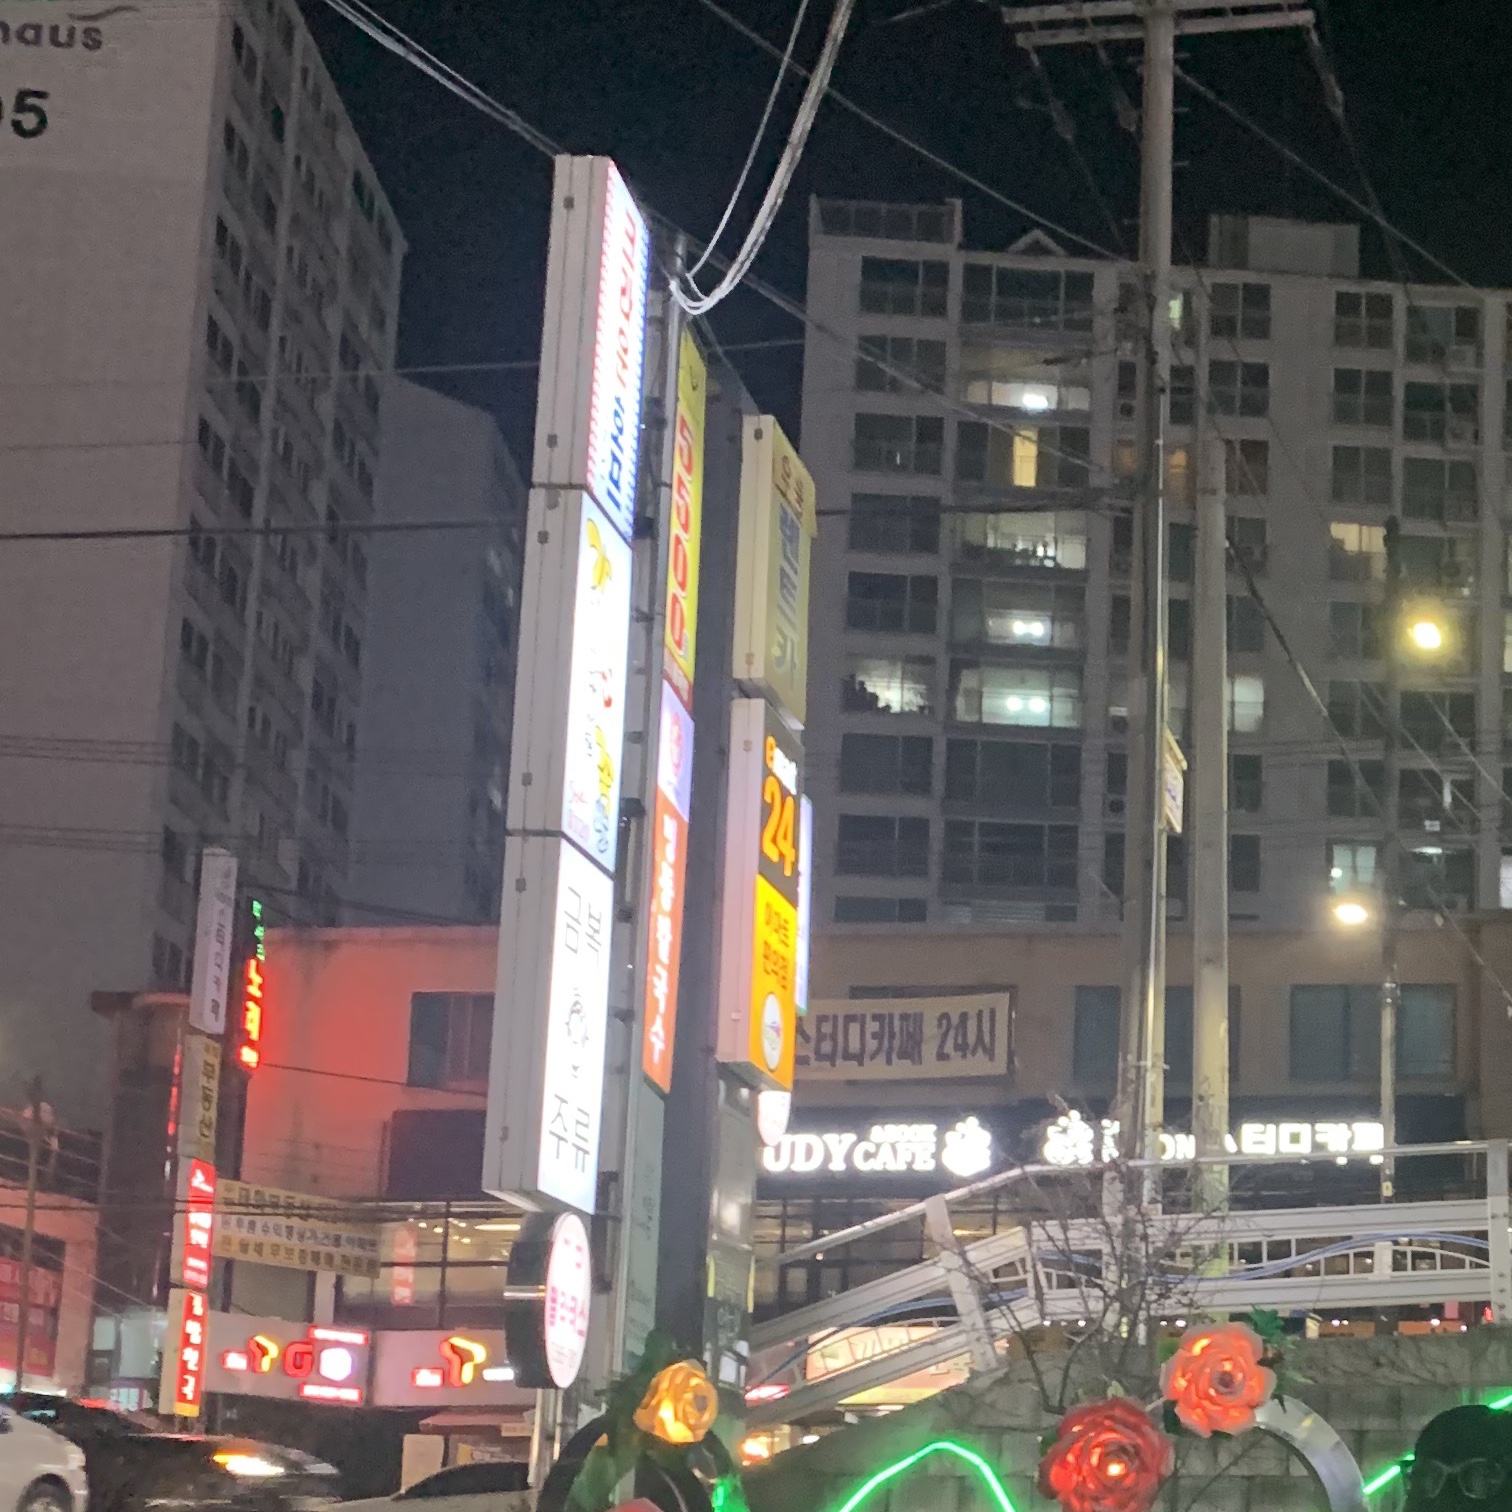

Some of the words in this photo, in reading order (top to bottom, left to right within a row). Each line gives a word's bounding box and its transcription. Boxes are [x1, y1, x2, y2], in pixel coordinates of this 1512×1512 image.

[0, 87, 51, 139] 5
[762, 774, 797, 877] 24
[561, 884, 604, 970] 금복
[935, 1009, 997, 1063] 24시
[547, 1093, 592, 1176] 주류
